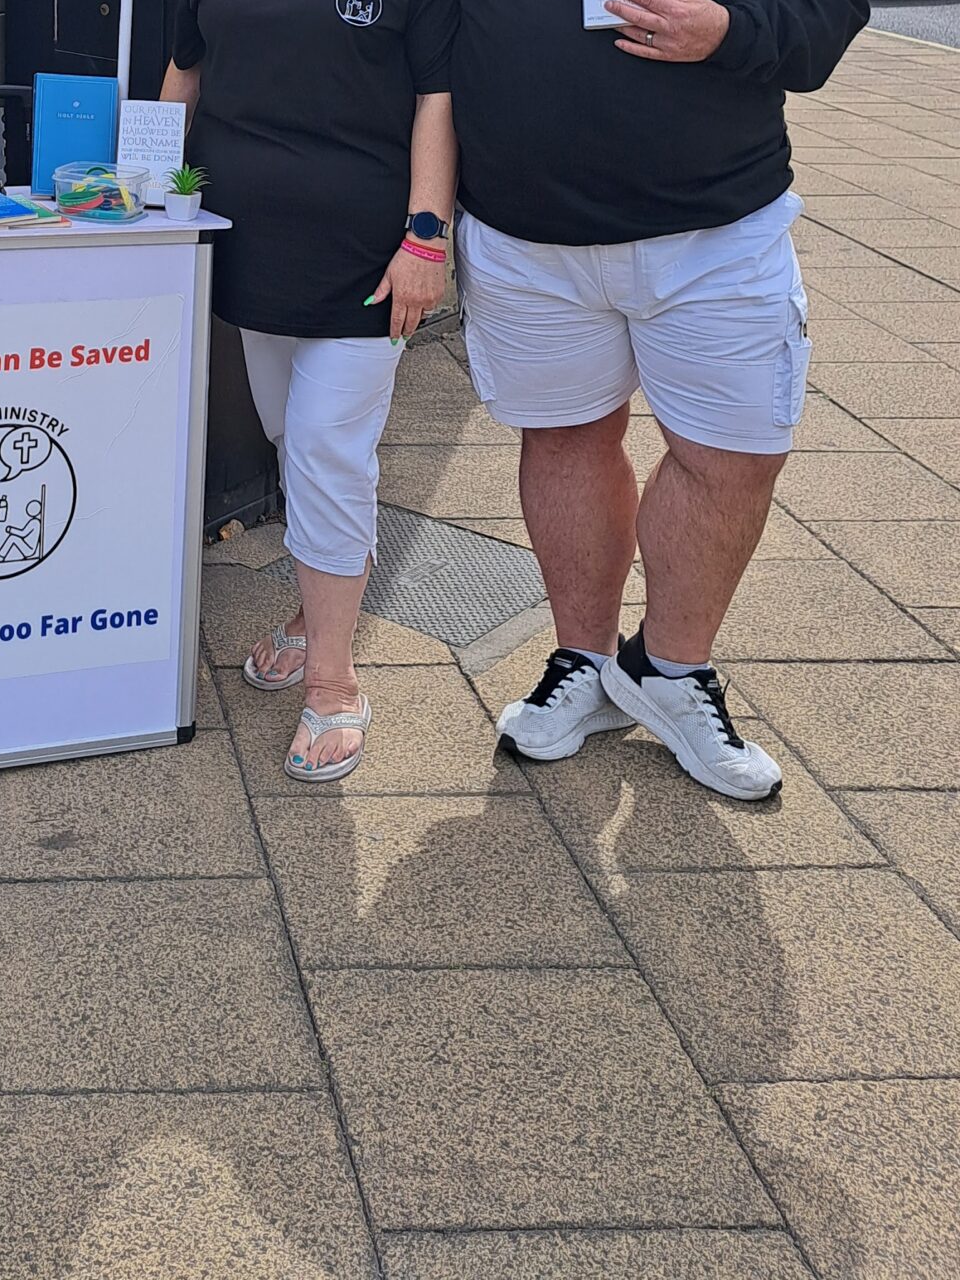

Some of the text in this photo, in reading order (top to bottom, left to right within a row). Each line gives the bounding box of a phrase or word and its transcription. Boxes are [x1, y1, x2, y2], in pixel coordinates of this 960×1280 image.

[171, 129, 182, 137] BE
[122, 136, 152, 149] YOUR
[141, 153, 151, 161] BE
[29, 347, 62, 369] Be
[70, 339, 151, 367] Saved
[41, 614, 83, 637] Far
[90, 607, 159, 630] Gone
